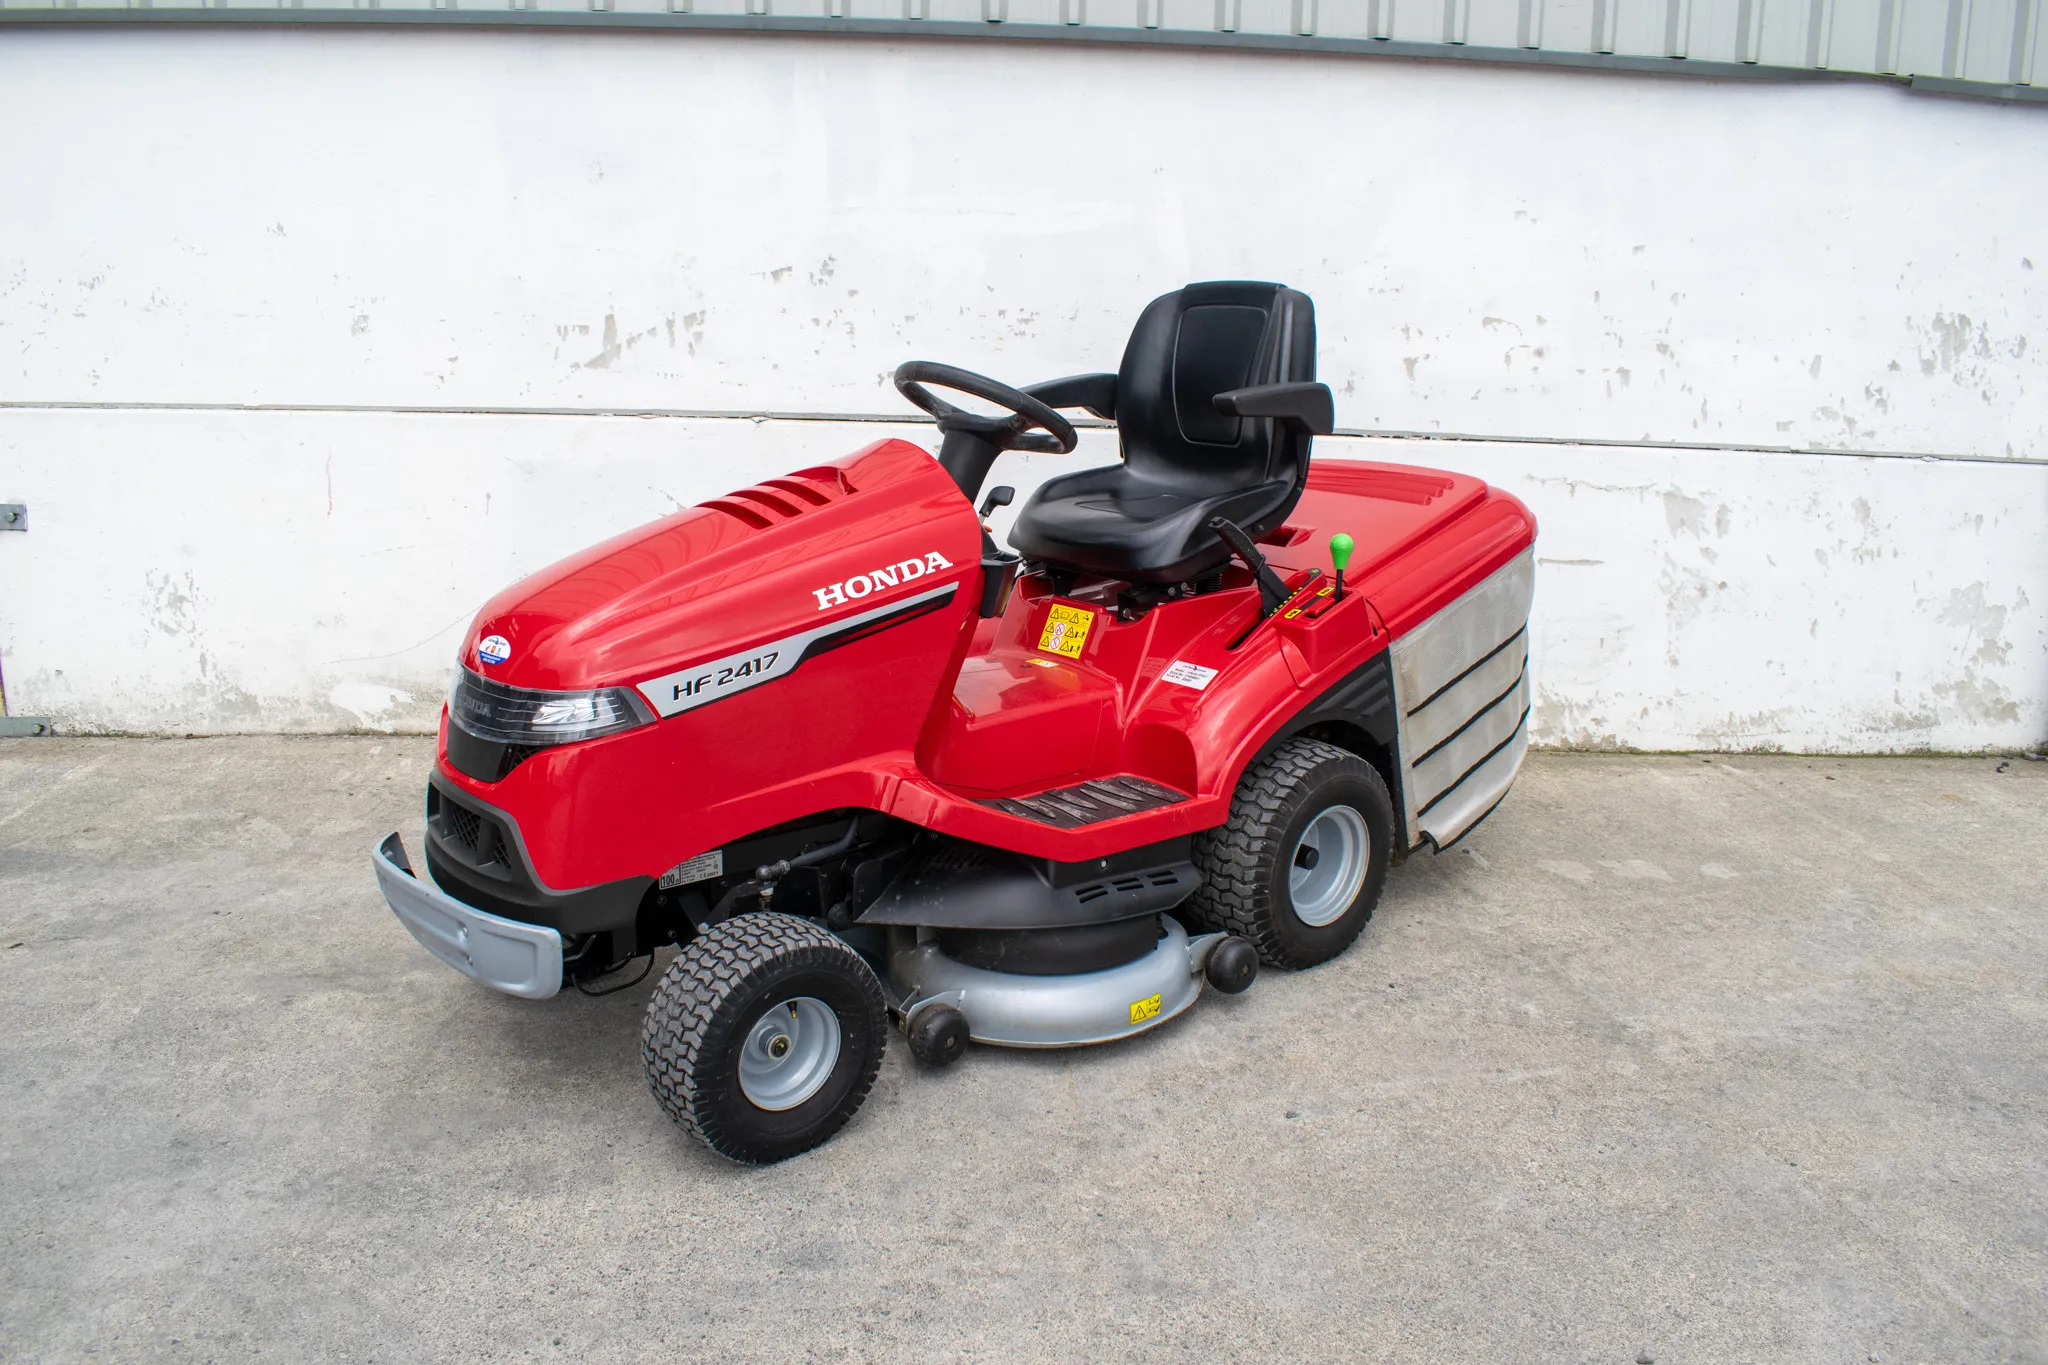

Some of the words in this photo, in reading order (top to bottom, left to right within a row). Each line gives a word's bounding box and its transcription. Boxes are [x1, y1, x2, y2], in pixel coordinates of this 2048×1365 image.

[812, 551, 953, 611] HONDA
[673, 673, 712, 701] HF
[717, 651, 780, 687] 2417
[662, 873, 675, 887] 100
